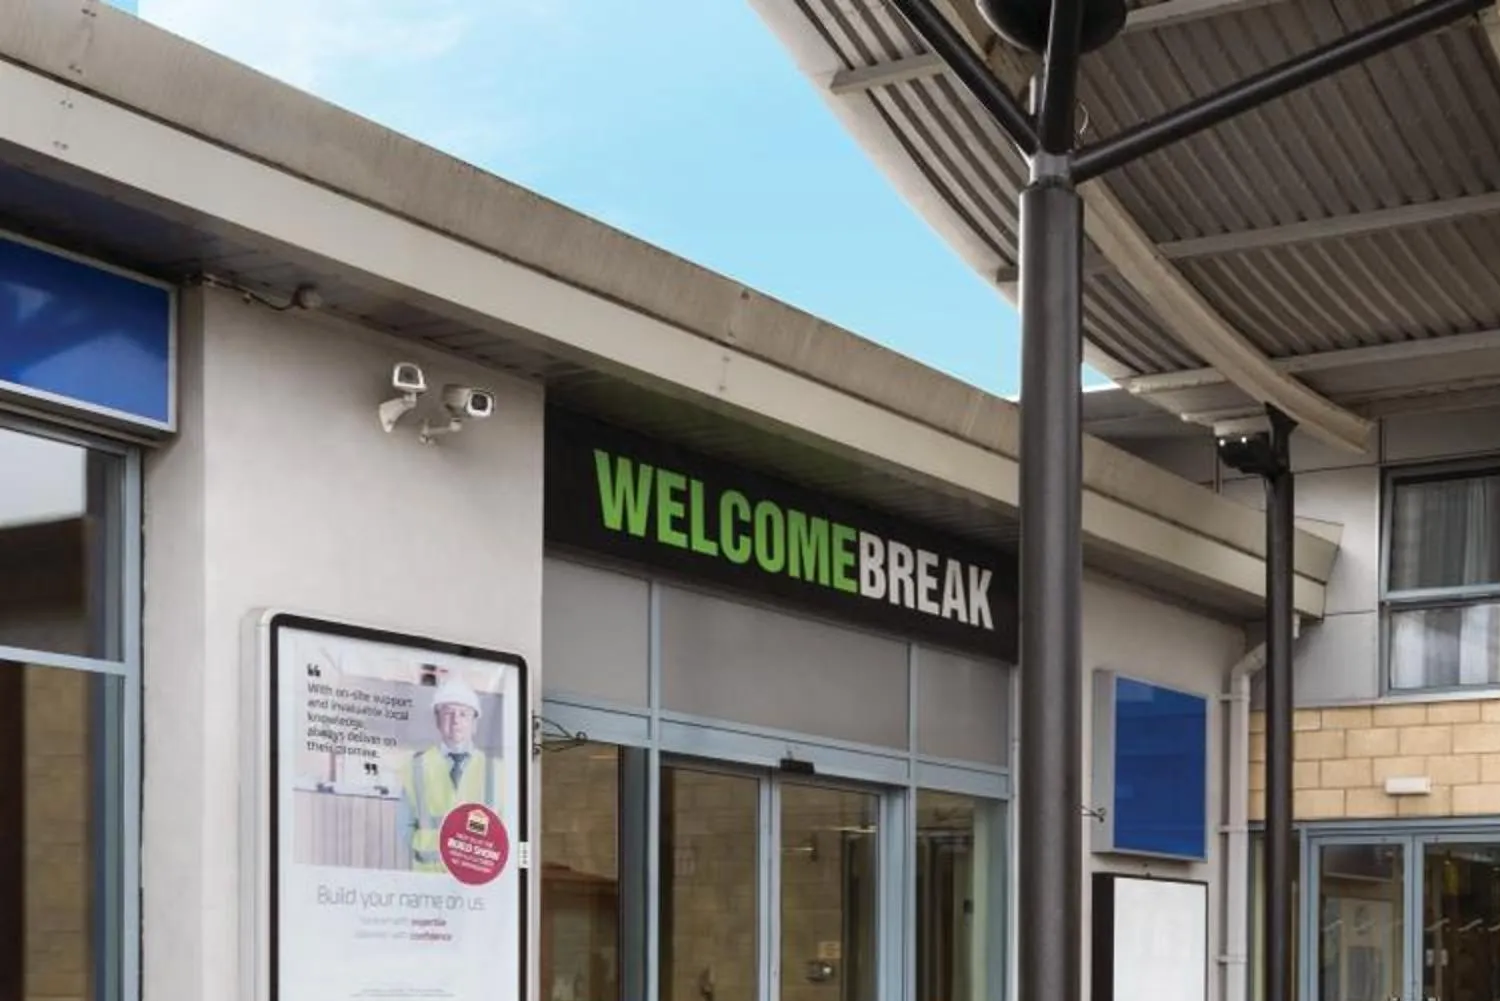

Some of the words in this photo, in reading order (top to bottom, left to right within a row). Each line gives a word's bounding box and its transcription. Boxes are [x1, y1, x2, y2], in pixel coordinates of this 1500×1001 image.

[308, 682, 333, 695] With
[317, 885, 357, 906] Build
[360, 890, 396, 909] your
[400, 893, 443, 910] name
[445, 894, 464, 911] on
